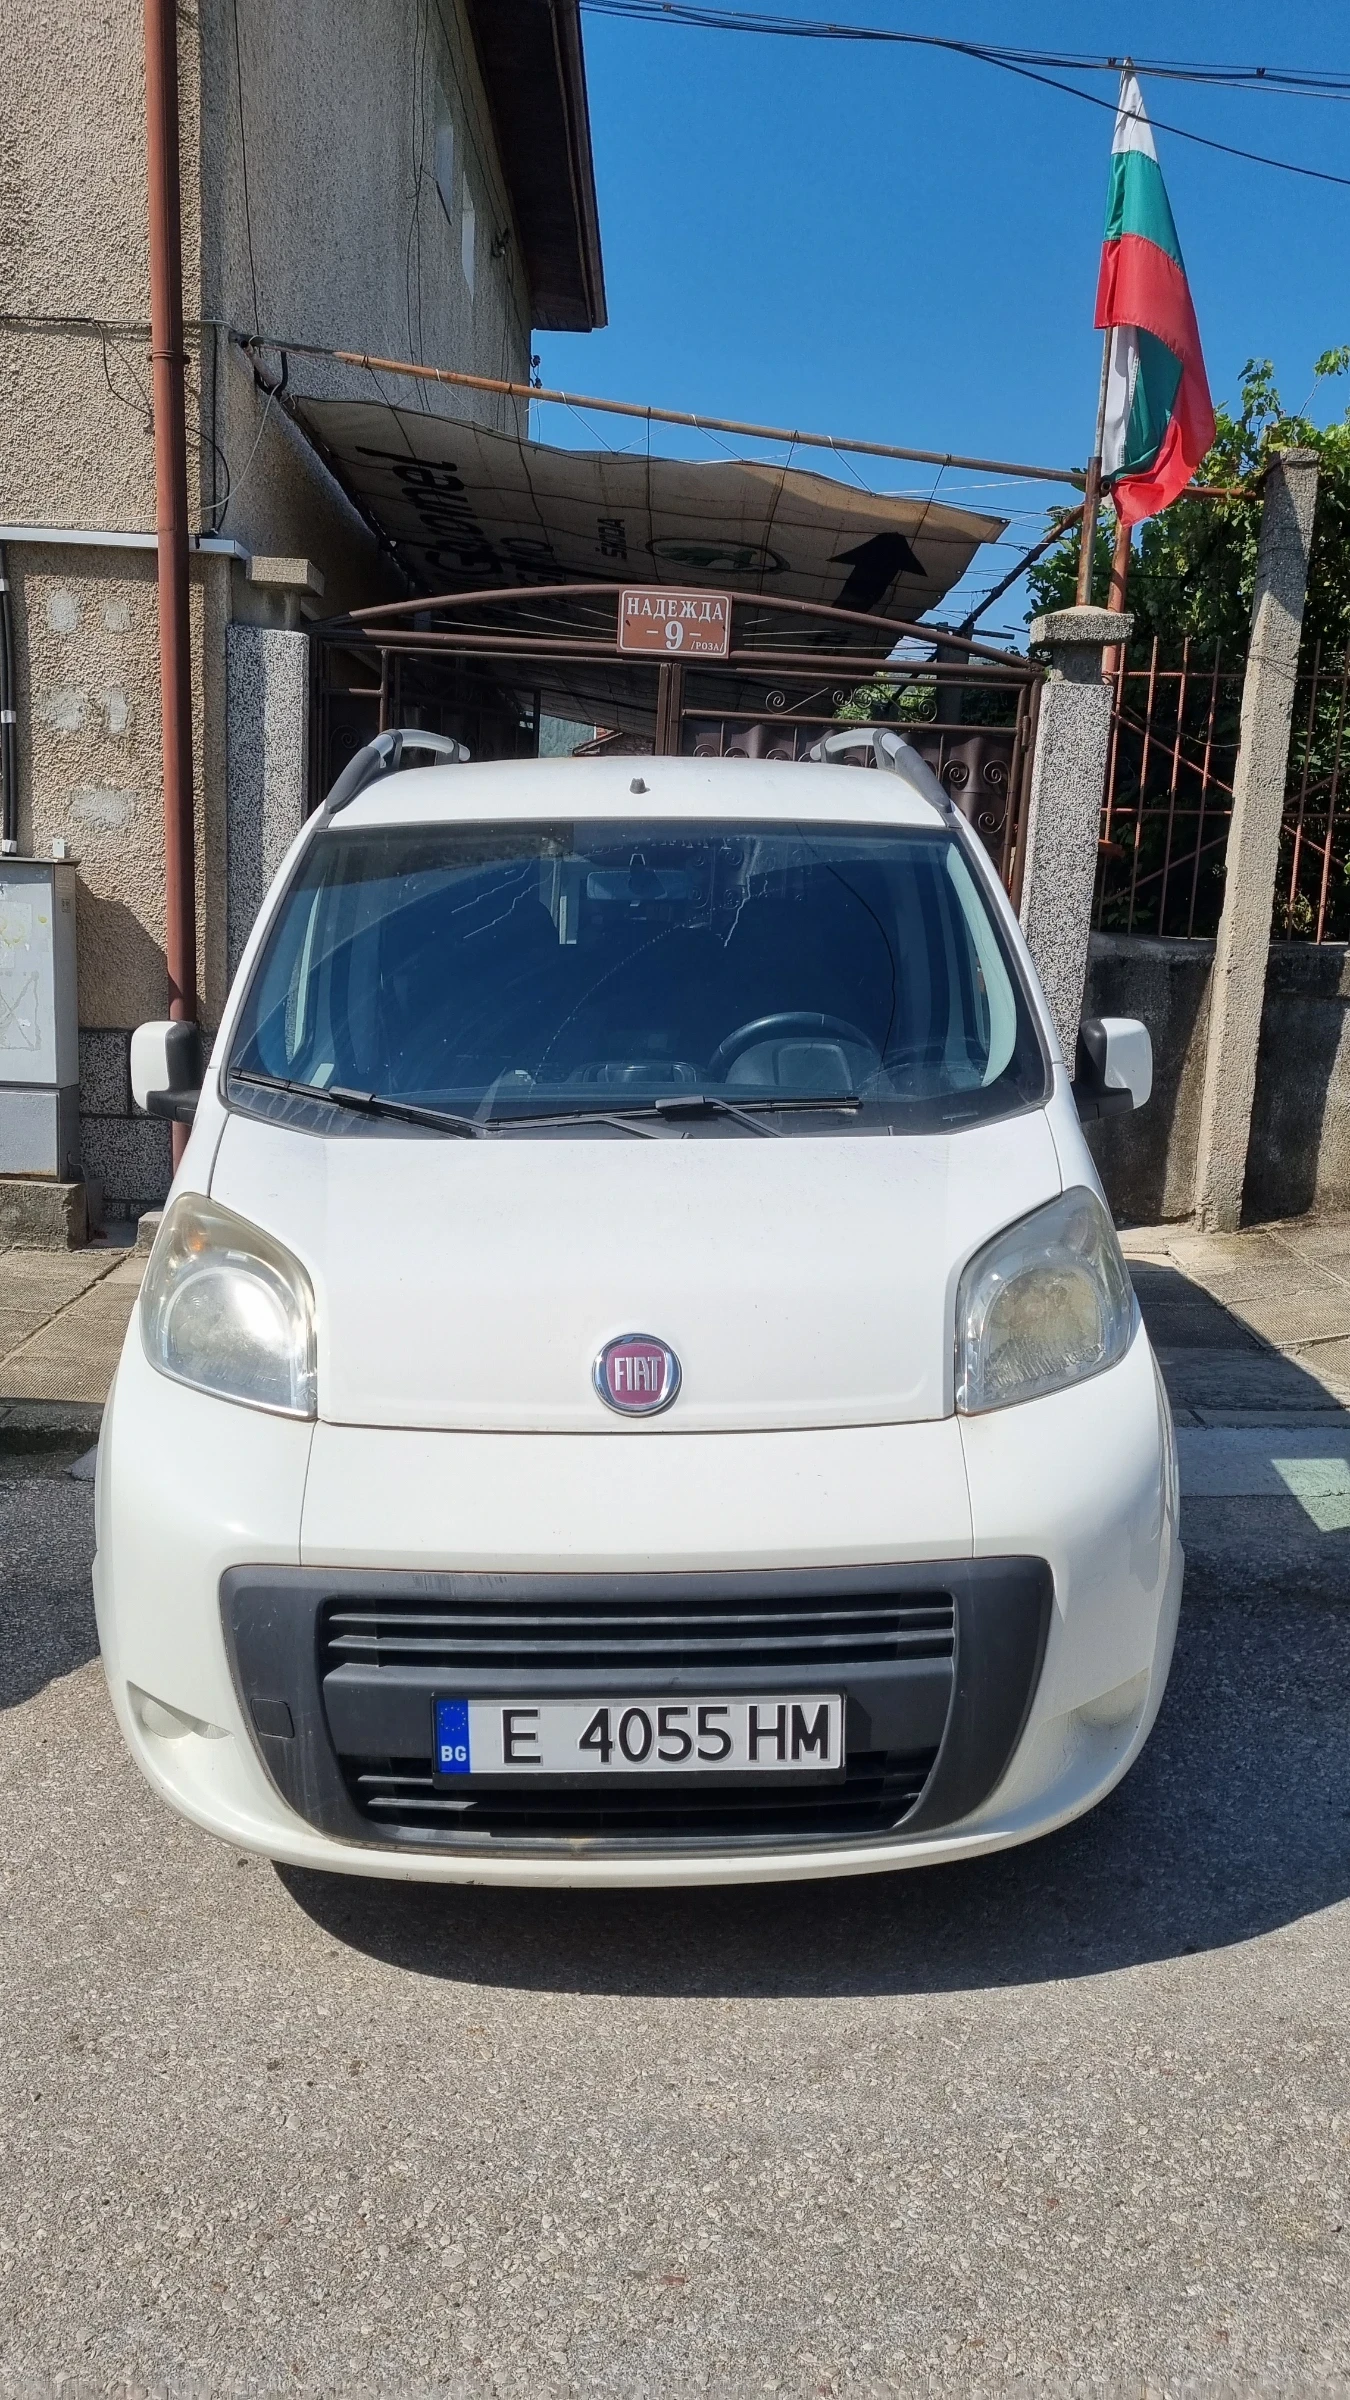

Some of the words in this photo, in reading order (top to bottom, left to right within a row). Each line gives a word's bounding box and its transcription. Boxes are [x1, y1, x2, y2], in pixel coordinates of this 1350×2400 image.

[627, 598, 724, 623] НАДЕЖДА
[614, 1356, 662, 1391] FIAT
[501, 1709, 541, 1764] E
[578, 1705, 732, 1763] 4055
[748, 1704, 830, 1762] HM
[441, 1745, 467, 1762] BG
